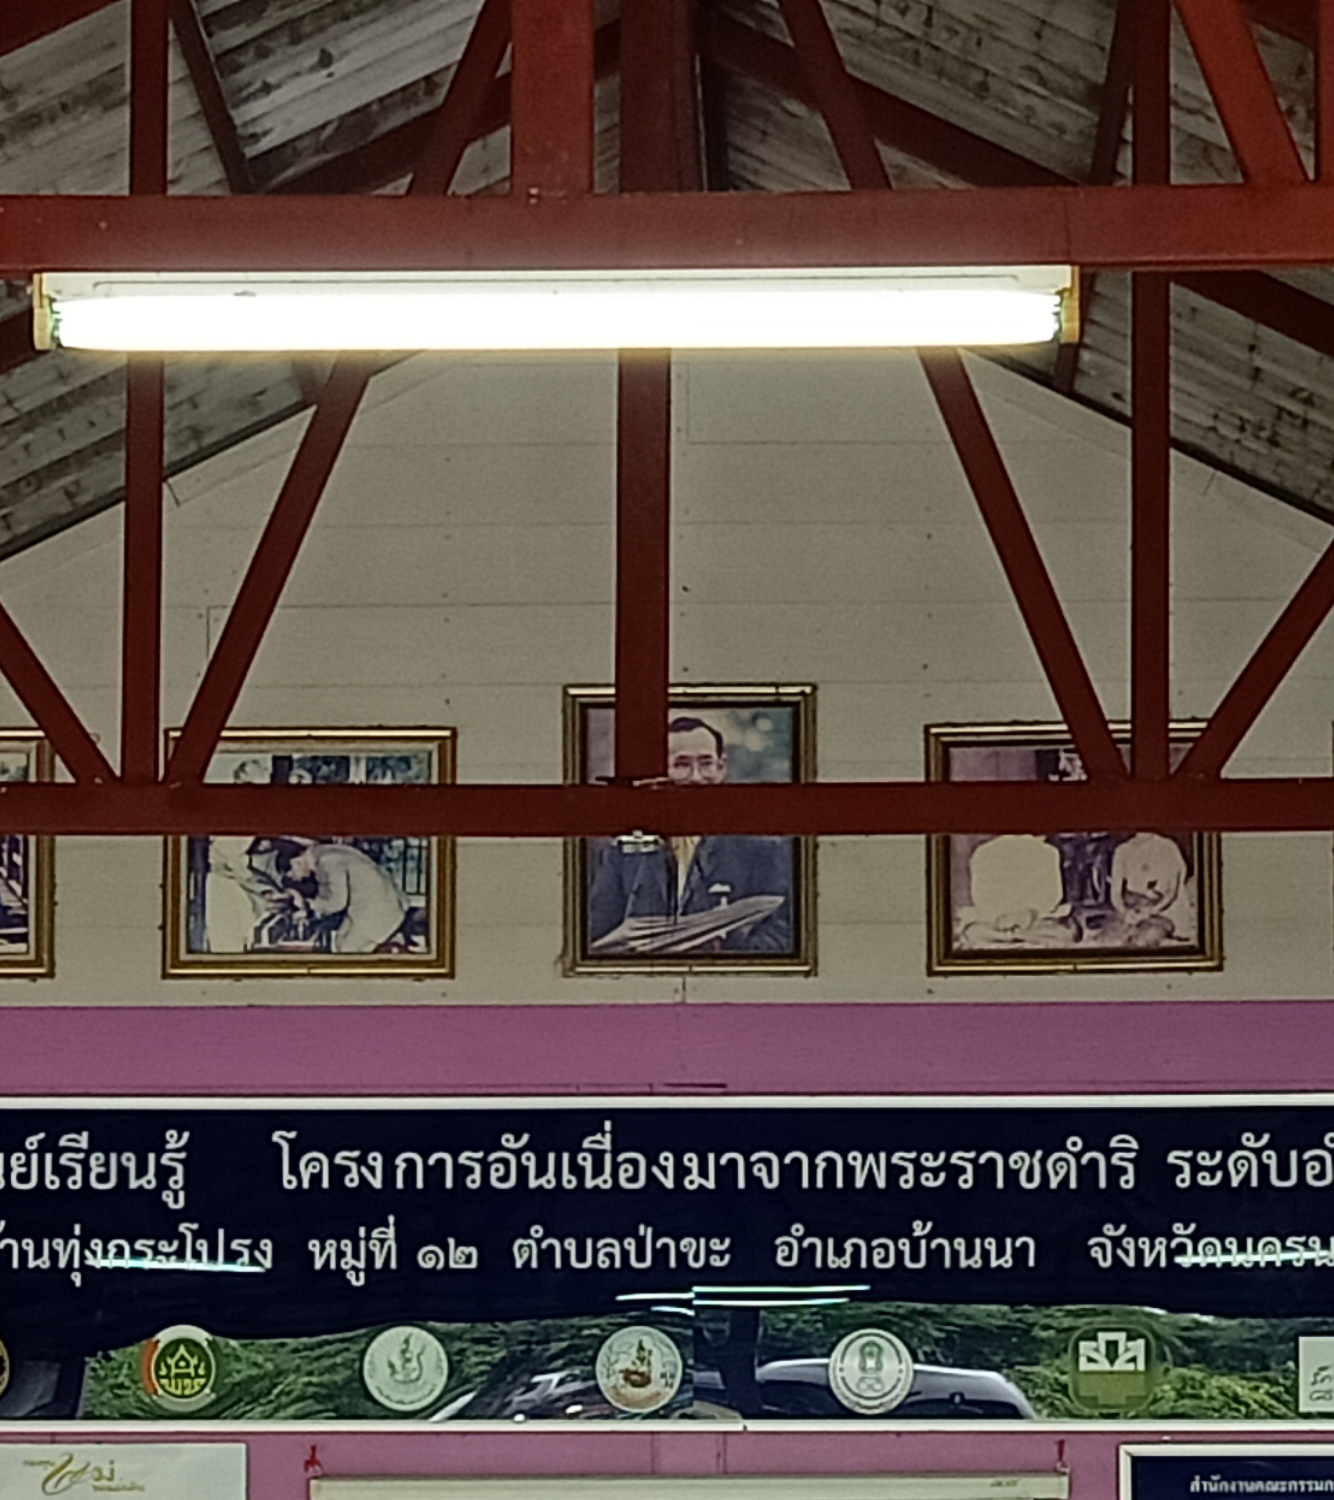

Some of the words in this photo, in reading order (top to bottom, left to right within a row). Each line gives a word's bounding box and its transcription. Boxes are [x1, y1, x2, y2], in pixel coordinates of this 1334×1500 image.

[271, 1121, 1141, 1192] โครงการอันเนื่องมาจากพระราชดำริ
[308, 1215, 397, 1286] หมู่ที่
[417, 1239, 479, 1272] ๑๒
[512, 1222, 731, 1273] ตำบลป่าขะ
[774, 1219, 1037, 1271] อำเภอบ้านนา
